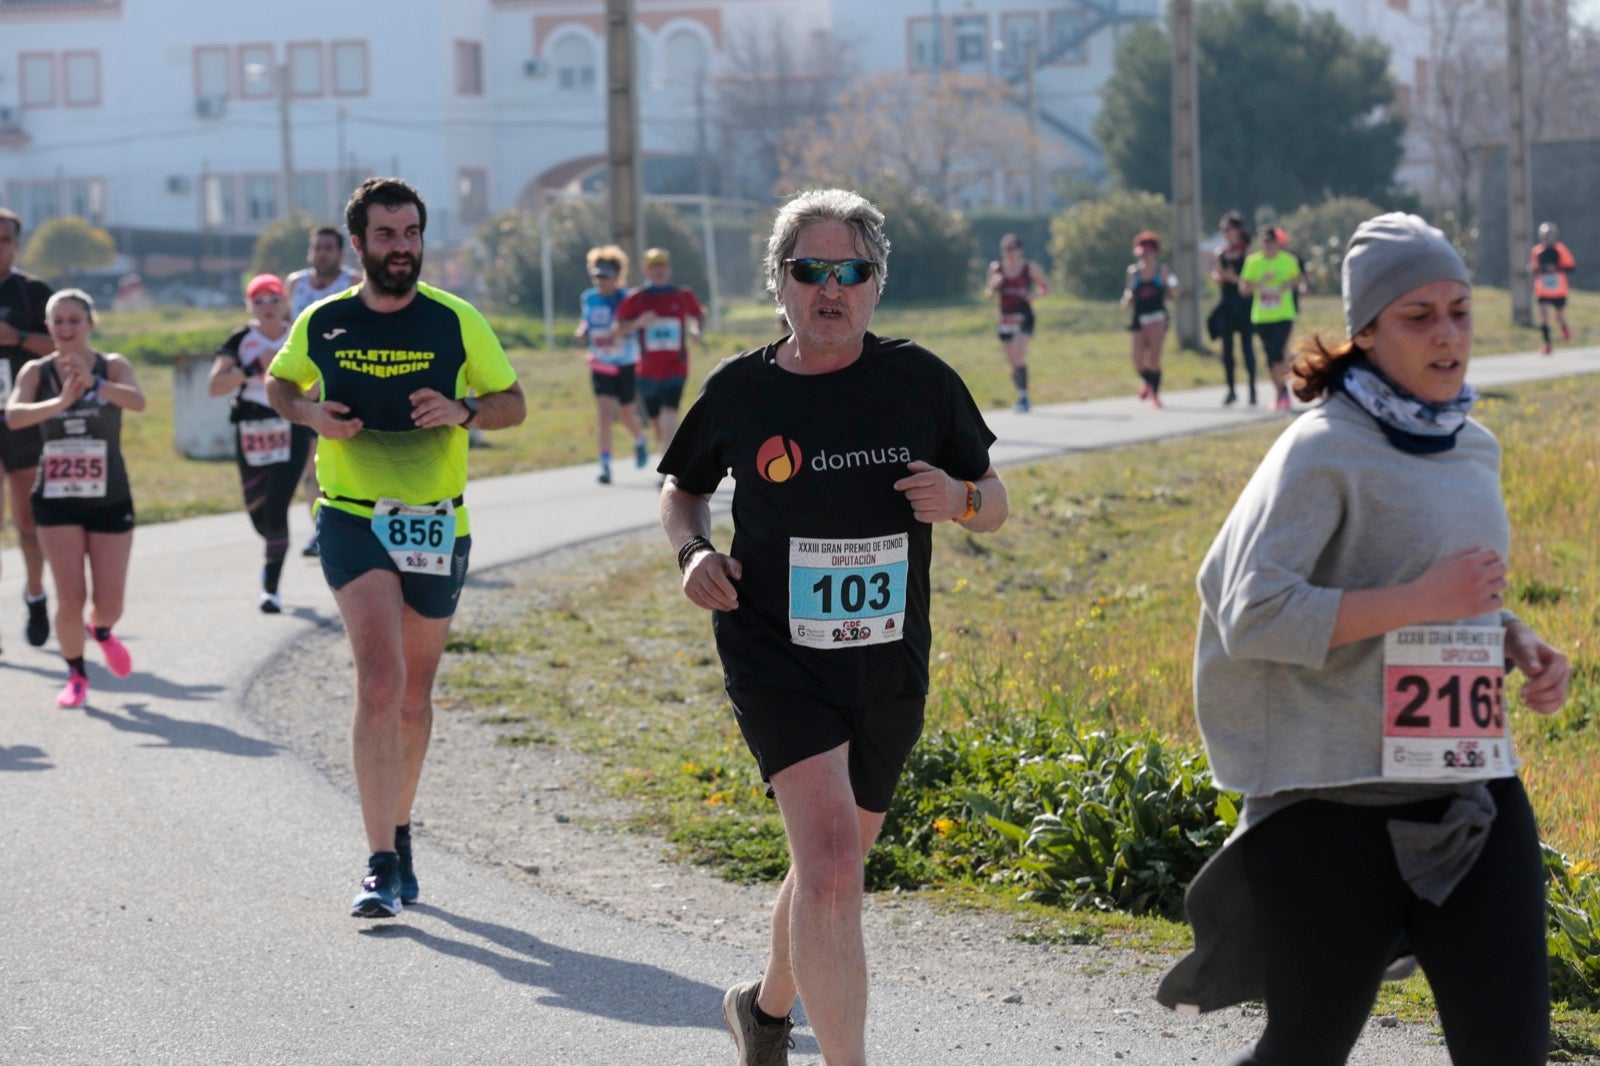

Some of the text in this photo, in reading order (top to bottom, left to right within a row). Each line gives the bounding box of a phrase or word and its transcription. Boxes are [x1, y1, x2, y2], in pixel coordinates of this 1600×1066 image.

[335, 350, 435, 362] ATLETISMO
[49, 459, 102, 478] 2255
[811, 447, 911, 471] domusa
[388, 519, 444, 547] 856
[799, 537, 903, 554] XXXIII GRAN PREMIO DE FONDO
[813, 572, 891, 613] 103
